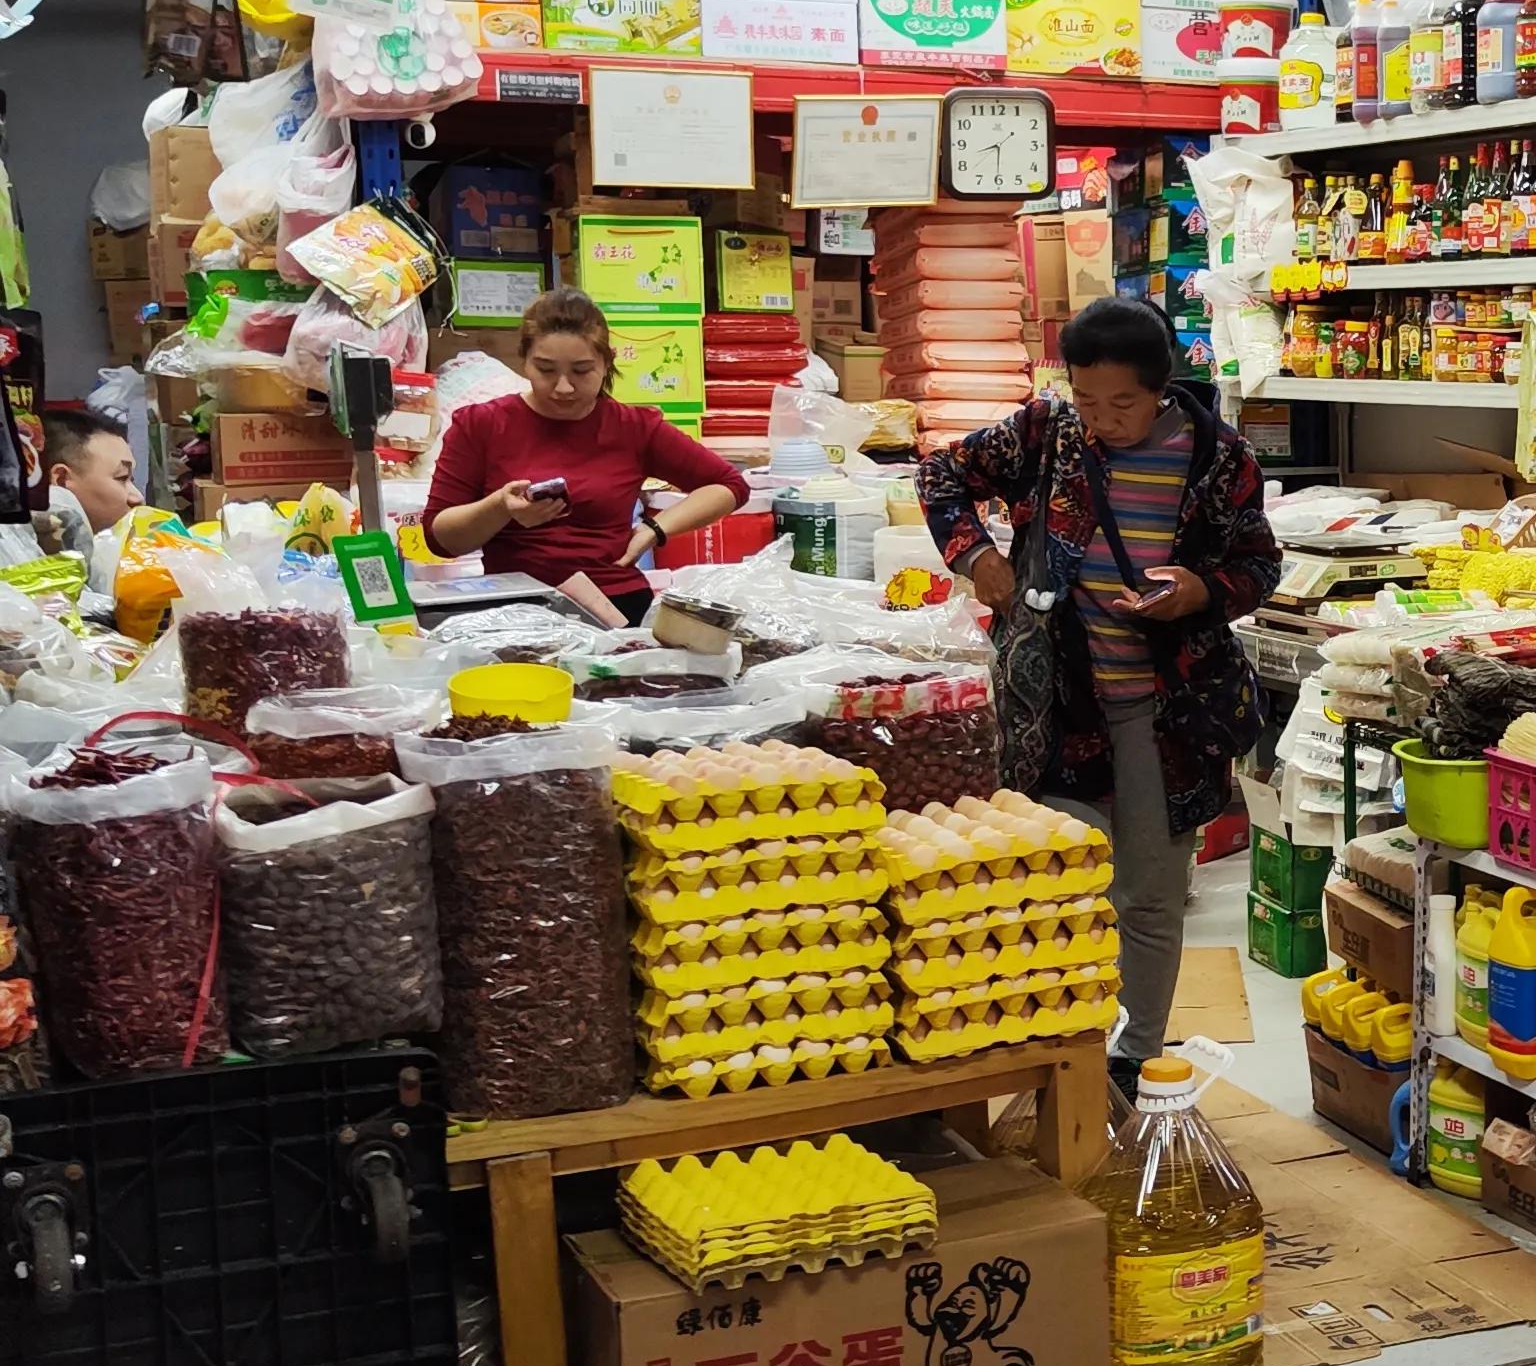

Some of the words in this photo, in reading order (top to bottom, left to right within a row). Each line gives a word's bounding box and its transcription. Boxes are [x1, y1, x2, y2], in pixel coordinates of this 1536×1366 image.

[1049, 16, 1095, 34] 淮山面
[971, 105, 984, 116] 11
[990, 104, 1005, 116] 12
[1014, 105, 1020, 117] 1
[957, 118, 971, 131] 10
[1030, 119, 1038, 130] 2
[957, 139, 967, 151] 9
[1030, 140, 1038, 151] 3
[957, 161, 967, 172] 8
[1030, 161, 1039, 173] 4
[976, 174, 983, 186] 7
[994, 174, 1003, 186] 6
[1015, 174, 1022, 186] 5
[811, 513, 828, 563] Mung
[1443, 1117, 1465, 1134] 立白
[676, 1297, 764, 1335] 绿佰康
